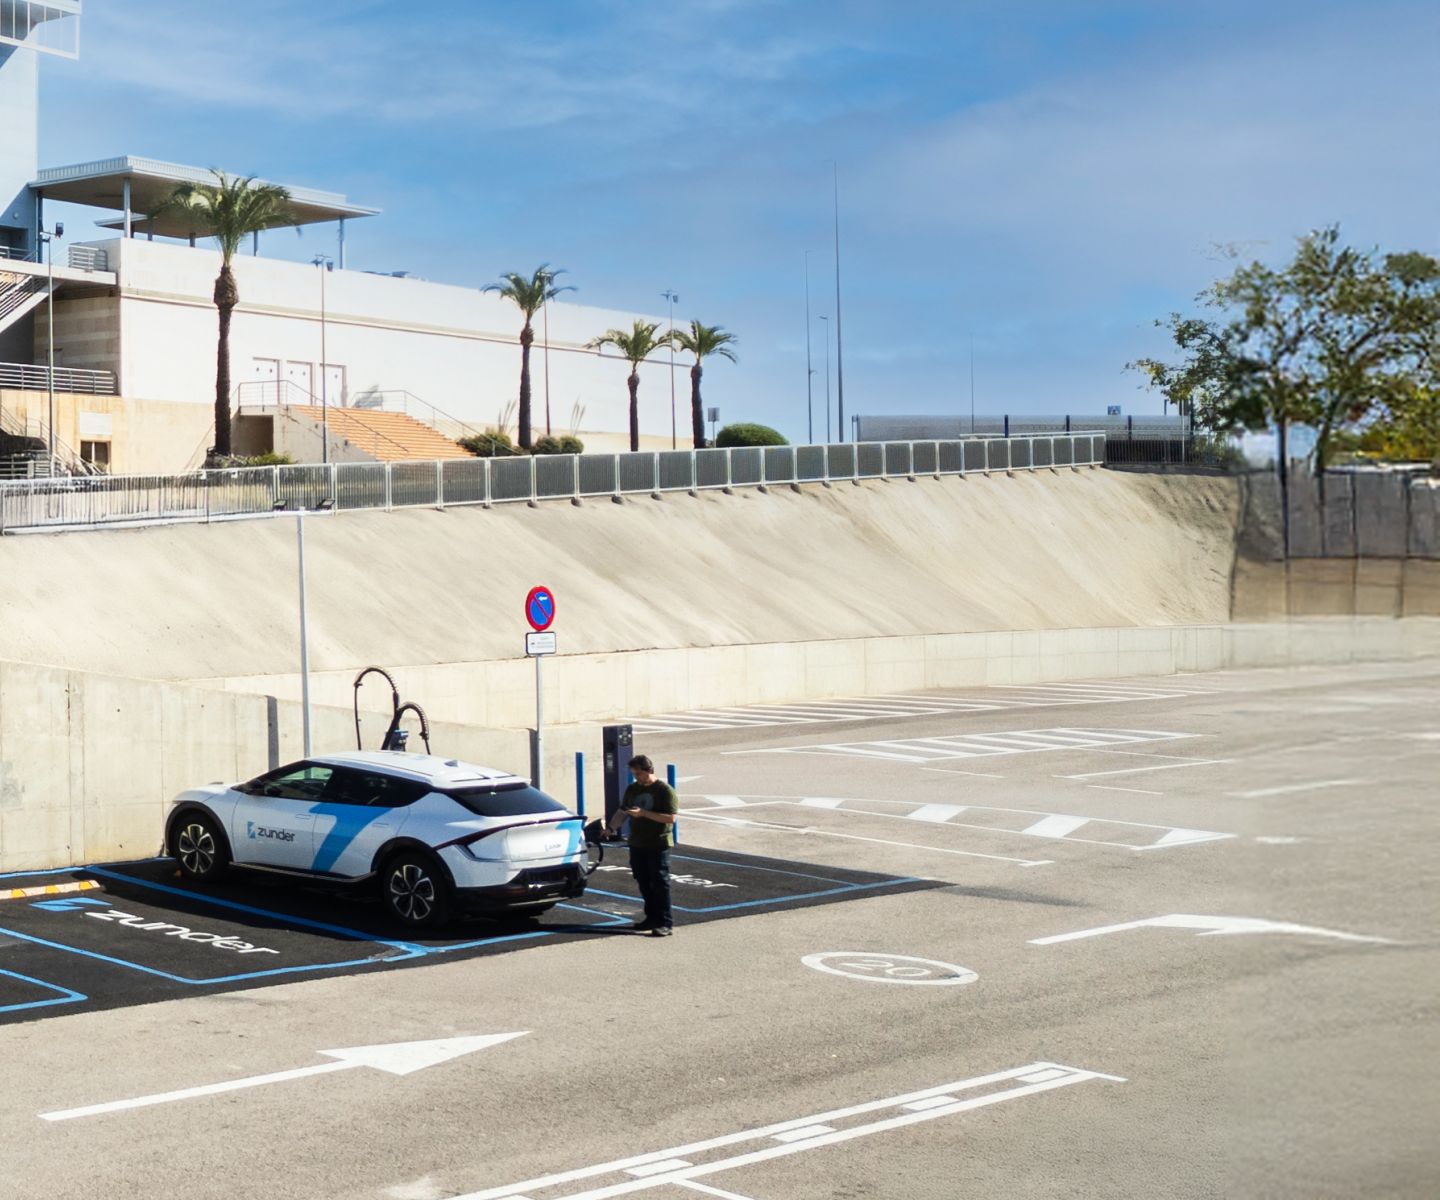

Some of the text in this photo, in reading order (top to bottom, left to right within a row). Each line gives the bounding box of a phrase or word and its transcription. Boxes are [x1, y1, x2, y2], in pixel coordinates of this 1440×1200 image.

[257, 827, 295, 842] zunder
[85, 909, 280, 954] zunder
[840, 959, 932, 977] 20
